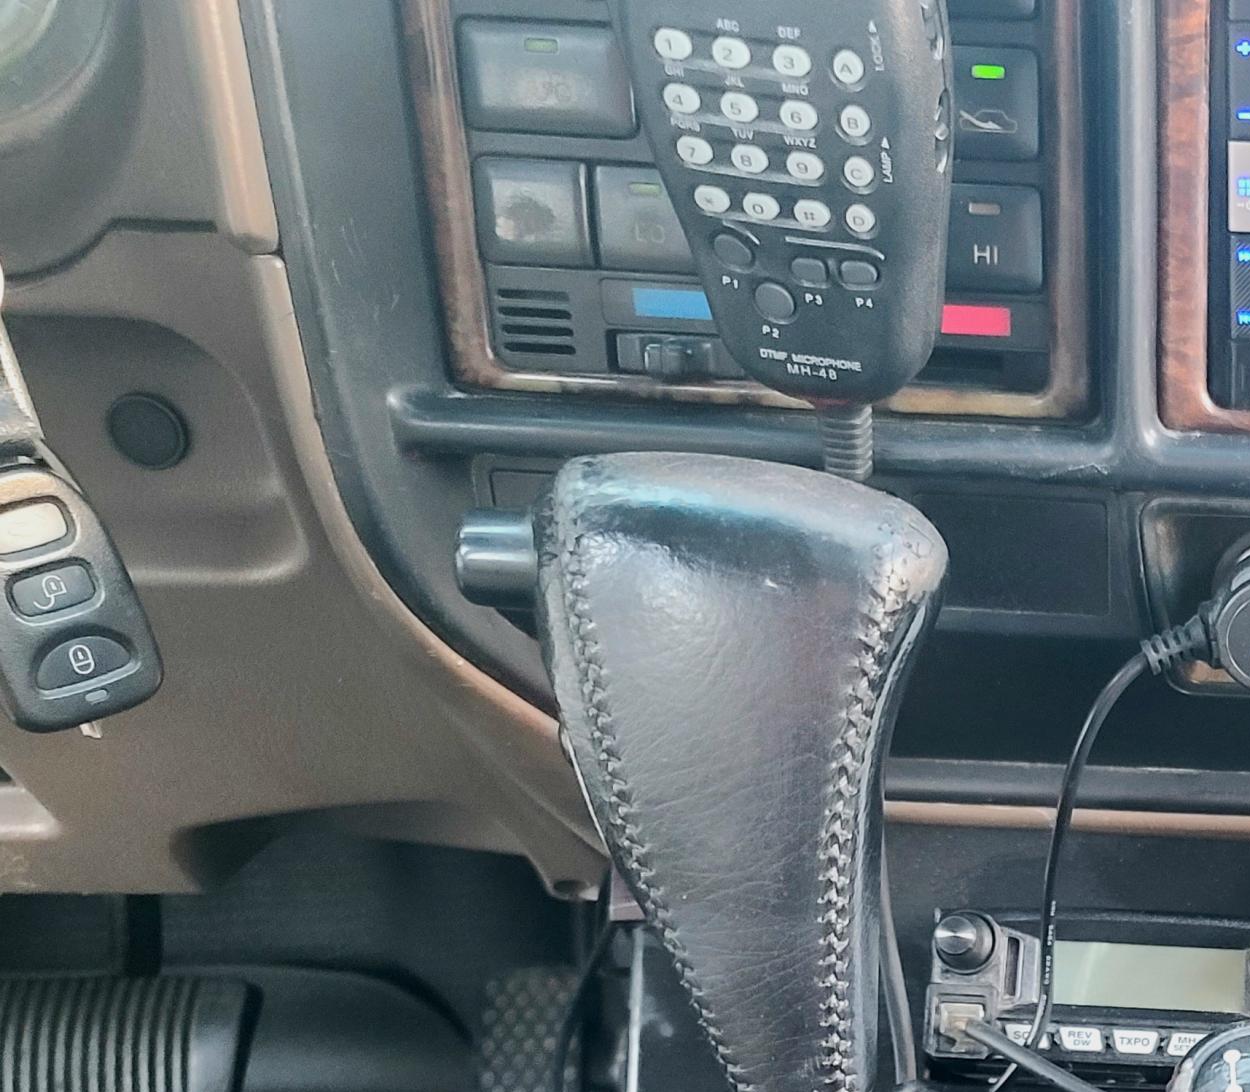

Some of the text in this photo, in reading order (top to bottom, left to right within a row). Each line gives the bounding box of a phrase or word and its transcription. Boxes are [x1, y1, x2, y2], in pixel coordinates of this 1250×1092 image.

[716, 18, 740, 33] ABC
[782, 56, 795, 69] 3
[840, 62, 853, 75] A
[730, 102, 742, 116] 5
[790, 111, 802, 124] 6
[847, 116, 860, 130] B
[740, 154, 752, 168] 8
[796, 161, 808, 174] 9
[882, 152, 894, 184] LAMP
[973, 244, 999, 265] HI
[721, 274, 740, 290] P1
[804, 292, 824, 306] P3
[854, 296, 874, 309] P4
[761, 324, 781, 340] P2
[790, 353, 863, 373] MICROPHONE
[786, 362, 837, 381] MH-48
[1067, 1030, 1094, 1039] REV
[1118, 1036, 1151, 1047] TXPO
[1072, 1039, 1092, 1047] DW
